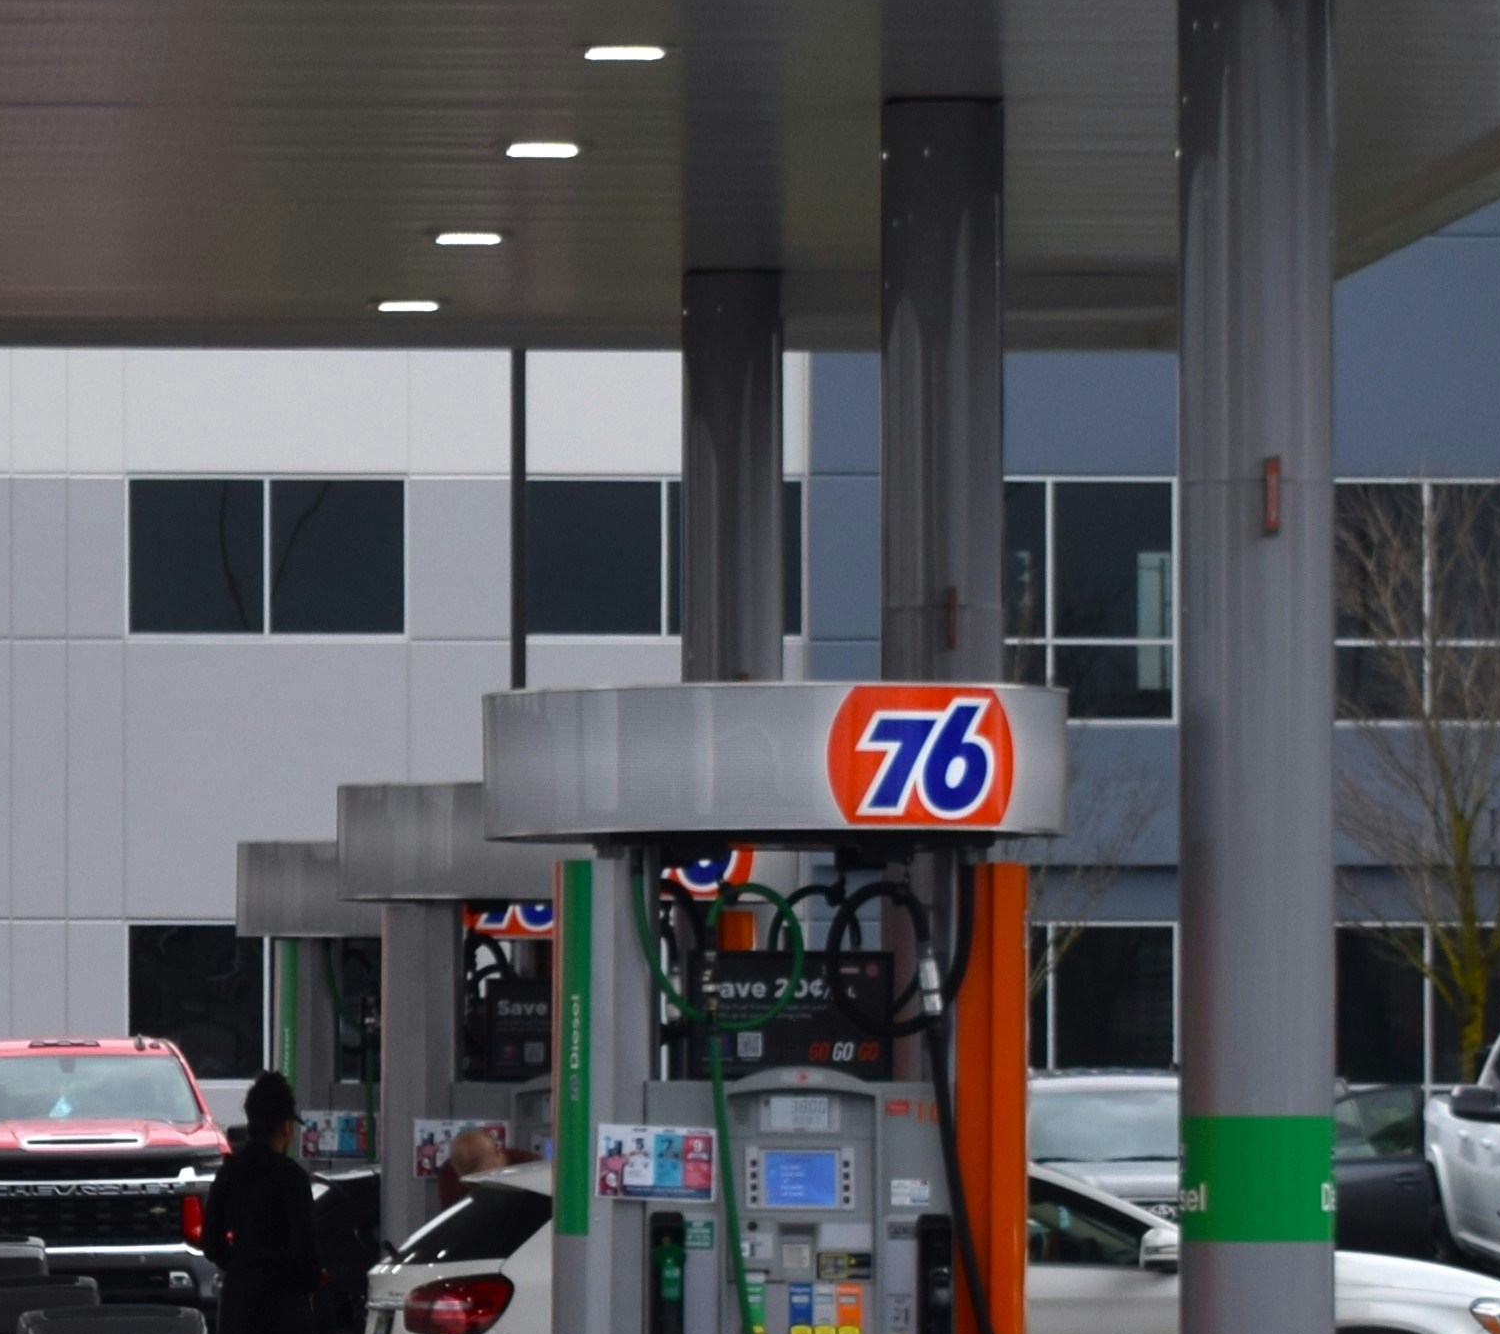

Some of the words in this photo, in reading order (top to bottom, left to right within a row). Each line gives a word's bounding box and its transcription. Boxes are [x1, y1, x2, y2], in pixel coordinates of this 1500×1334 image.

[854, 697, 996, 820] 76
[718, 978, 767, 999] ave
[497, 999, 548, 1017] Save
[569, 994, 581, 1069] Diesel
[808, 1041, 830, 1062] GO
[832, 1040, 854, 1062] GO
[858, 1041, 880, 1062] GO
